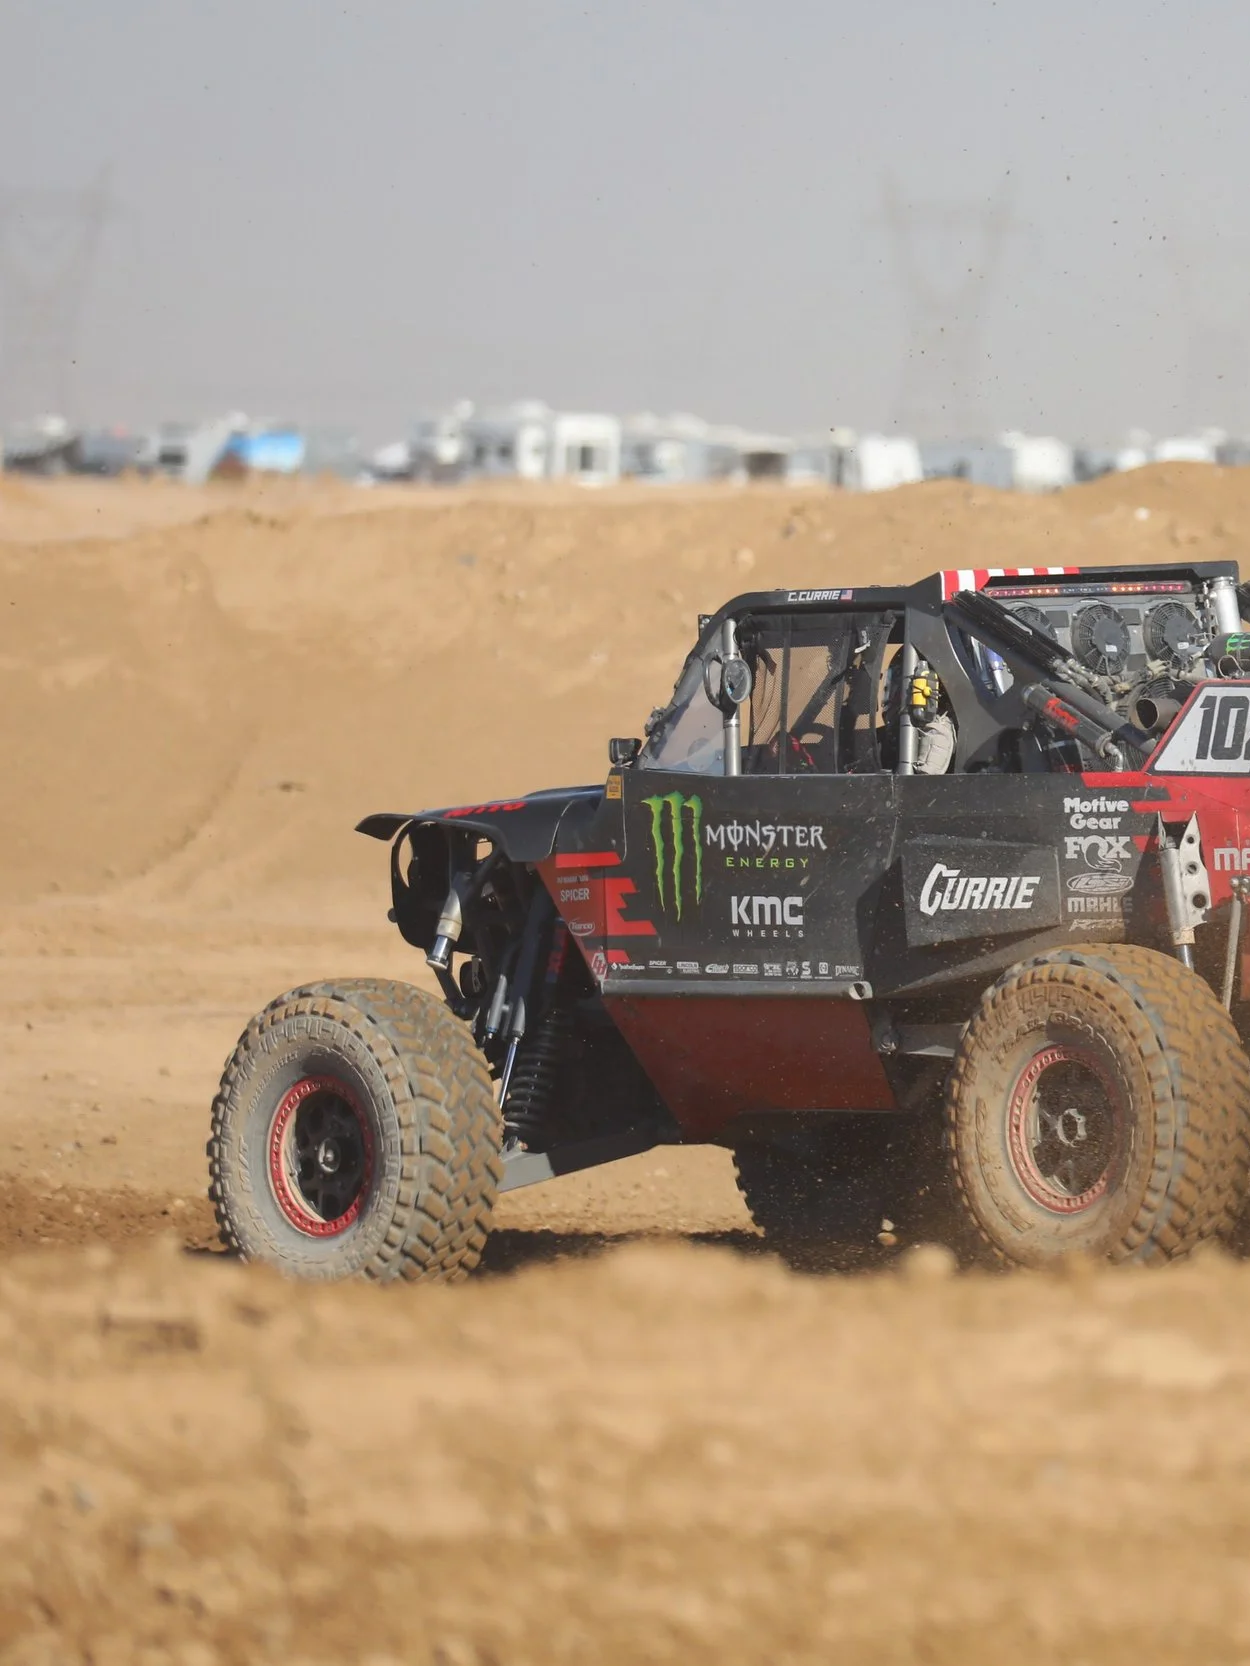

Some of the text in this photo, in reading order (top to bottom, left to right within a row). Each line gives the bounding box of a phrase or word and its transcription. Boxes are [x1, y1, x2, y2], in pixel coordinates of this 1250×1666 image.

[1064, 796, 1130, 813] Motive
[1070, 814, 1122, 829] Gear
[705, 819, 828, 852] MONSTER
[1063, 834, 1132, 873] FOX
[726, 857, 809, 868] ENERGY
[560, 887, 590, 903] SPICER
[919, 862, 1041, 917] CURRIE
[731, 895, 804, 925] KMC
[1067, 897, 1133, 913] MAHLE
[732, 929, 804, 938] WHEELS
